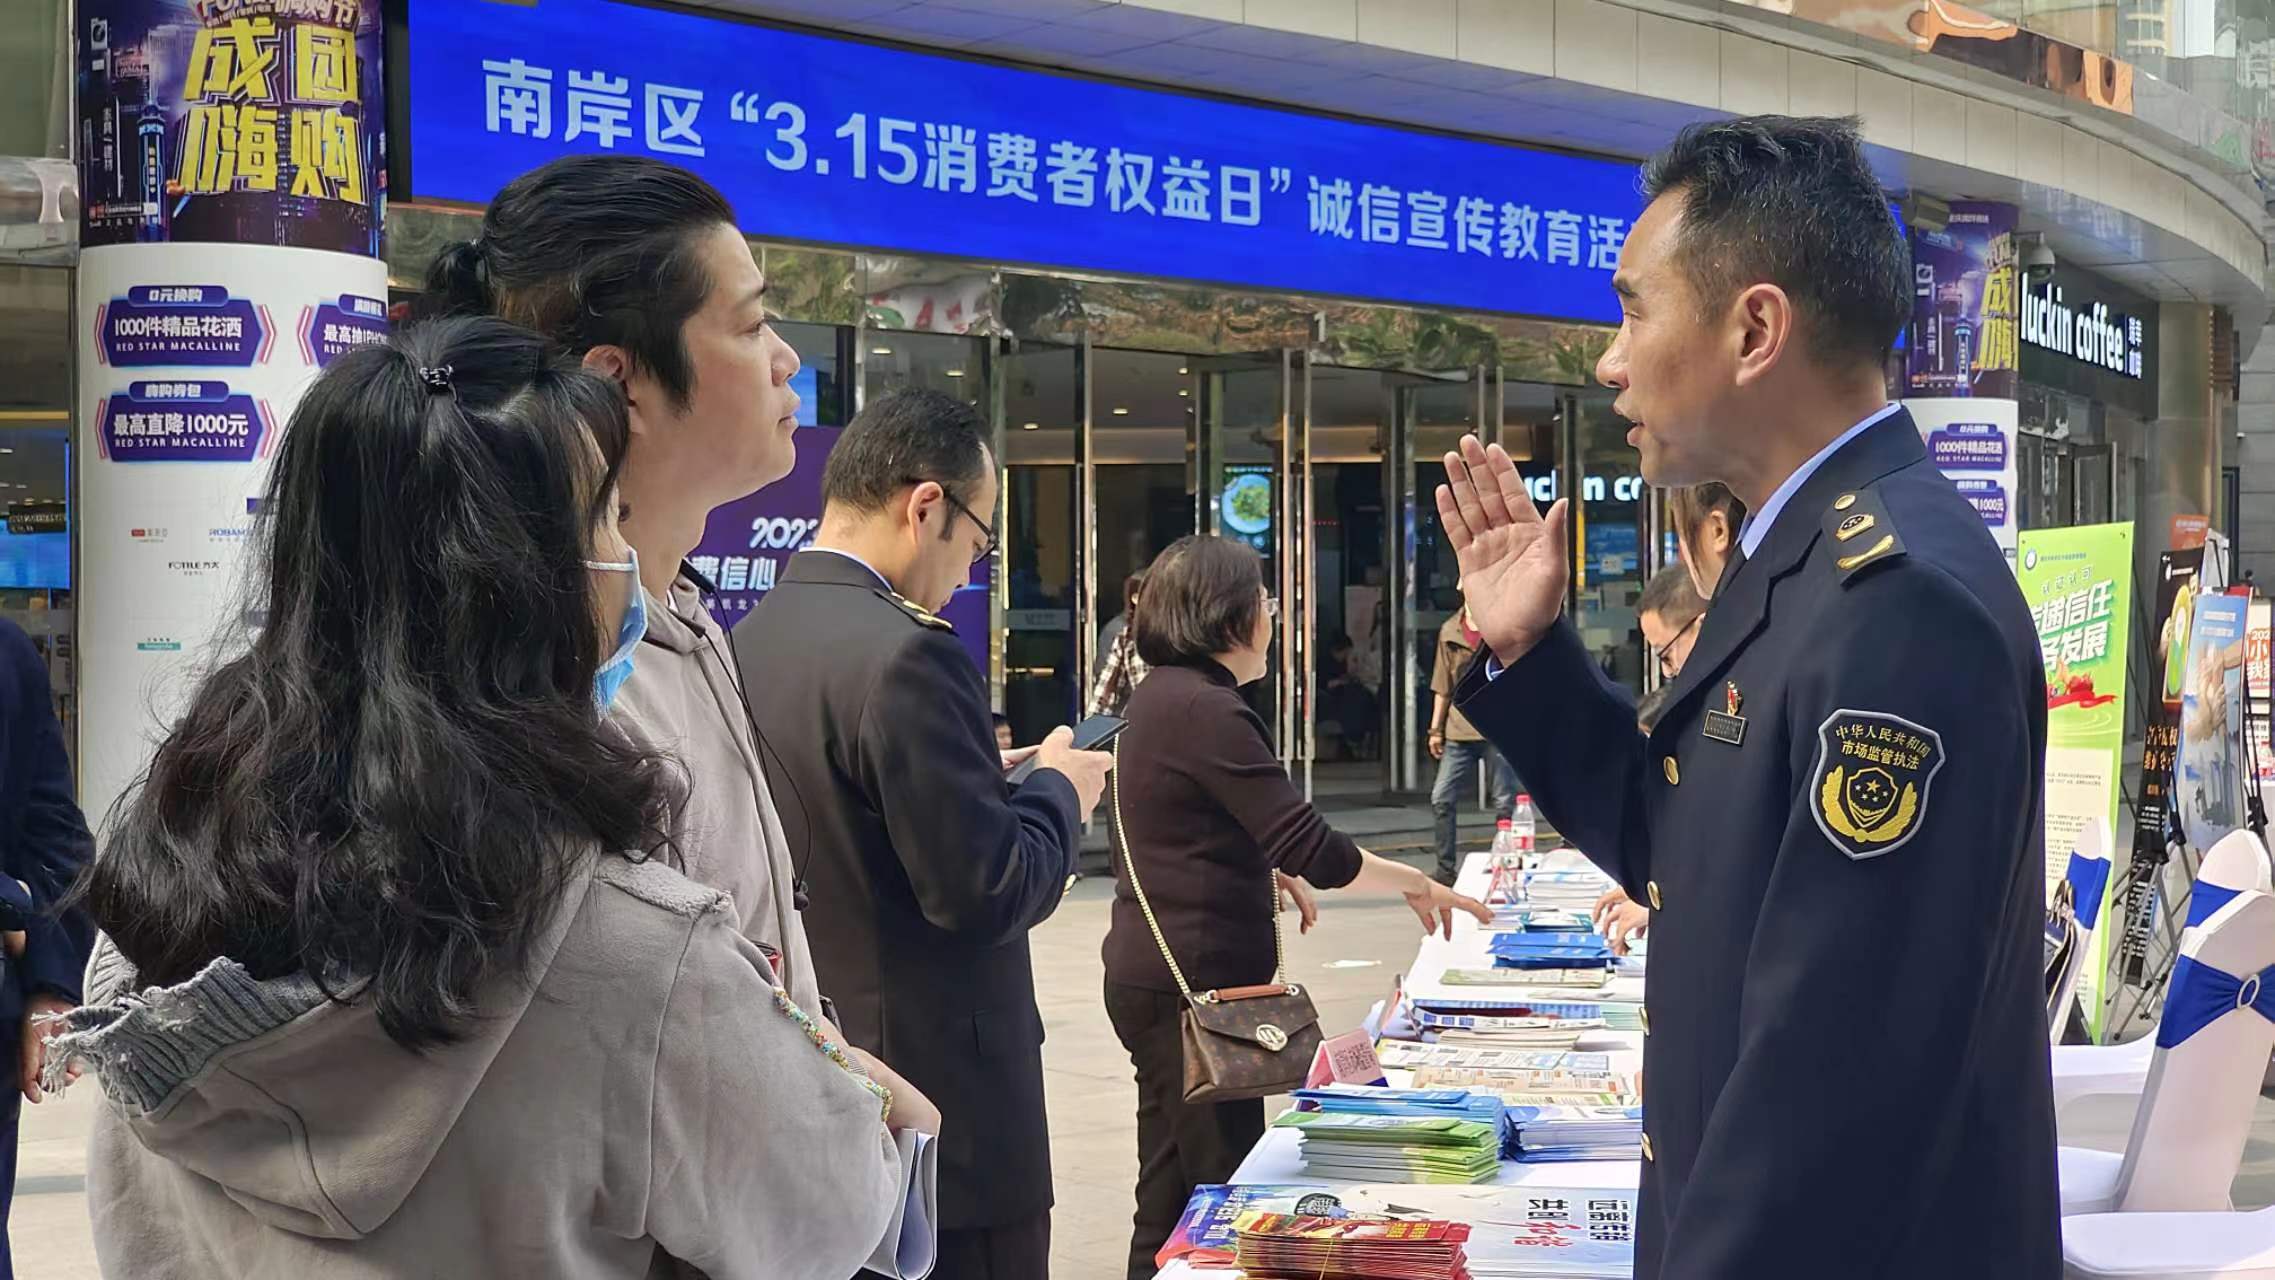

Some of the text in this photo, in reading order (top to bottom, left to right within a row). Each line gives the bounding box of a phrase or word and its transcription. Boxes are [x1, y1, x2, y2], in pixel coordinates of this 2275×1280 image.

[183, 17, 358, 100] 成团
[180, 104, 361, 200] 嗨购
[115, 316, 243, 338] 1000件精品花洒
[2021, 271, 2072, 355] luckin
[2075, 301, 2124, 372] coffee
[116, 342, 241, 352] RED STAR MACALLINE
[114, 413, 249, 437] 最高直降1000元
[115, 439, 245, 448] RED STAR MACALLINE
[1836, 724, 1932, 758] 中华人民共和国
[1842, 740, 1920, 770] 市场监管执法
